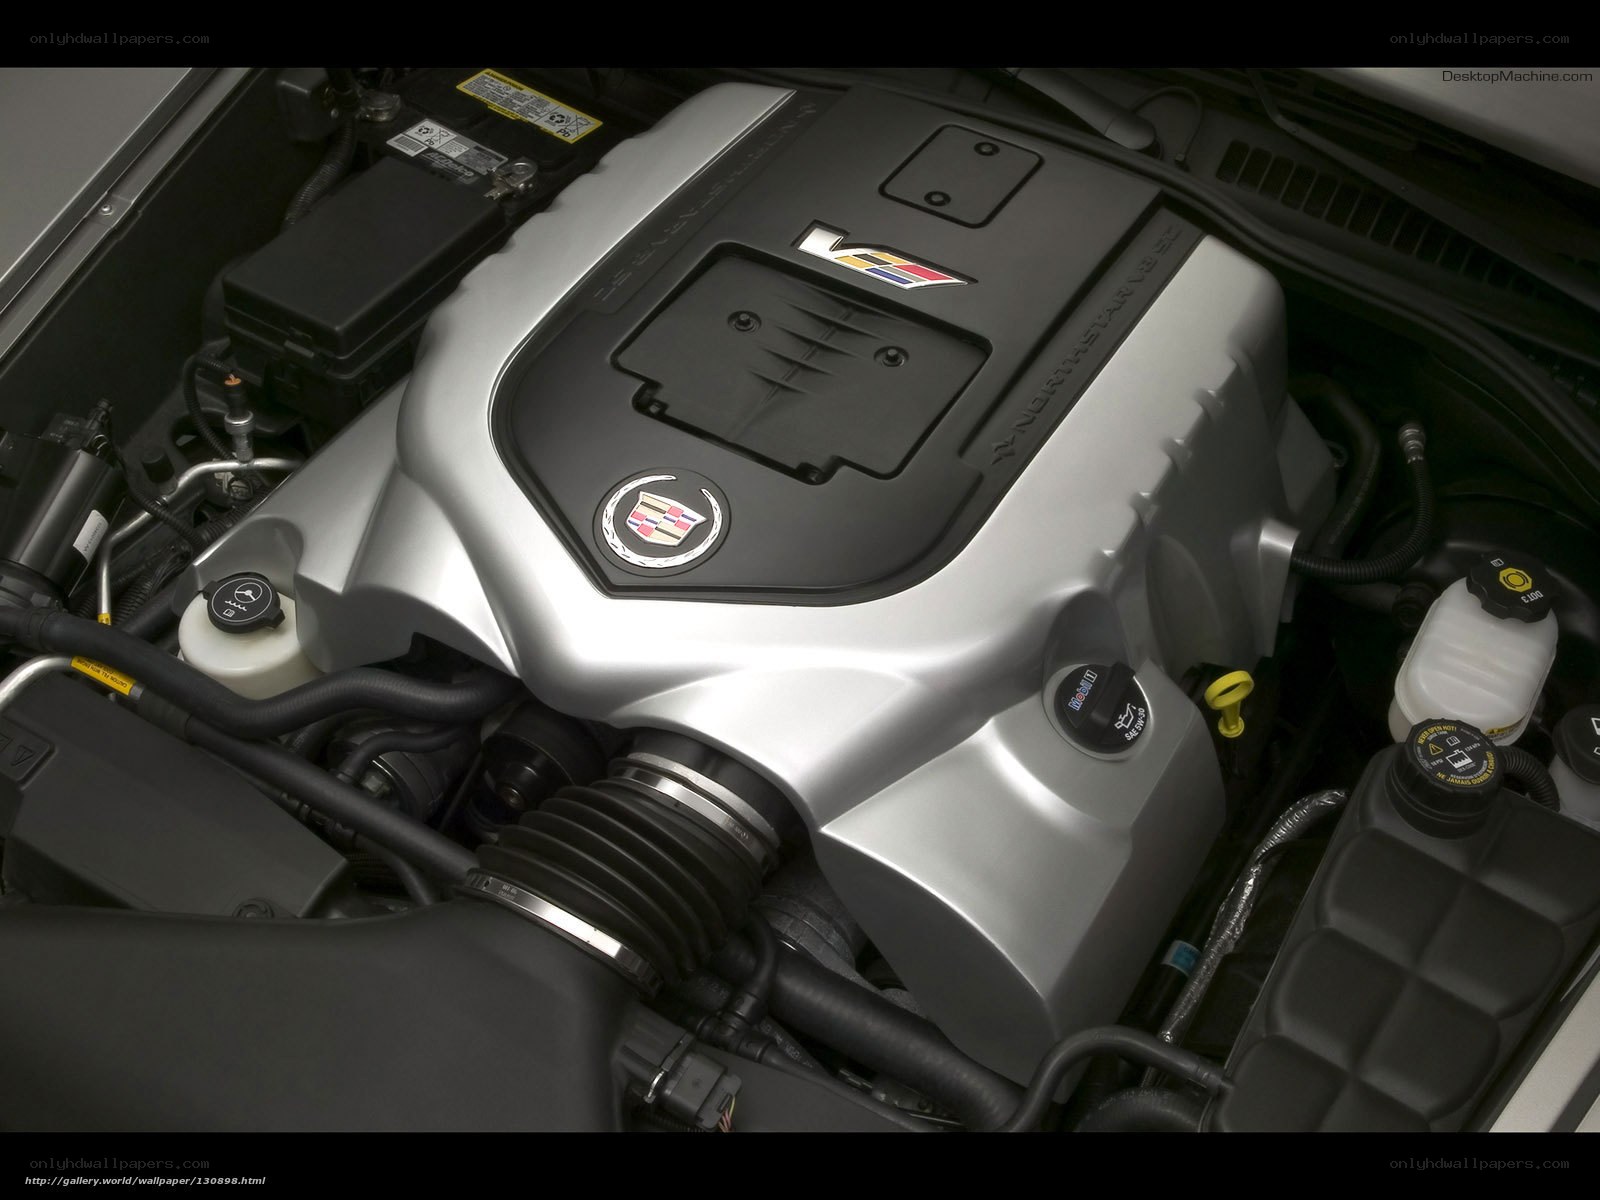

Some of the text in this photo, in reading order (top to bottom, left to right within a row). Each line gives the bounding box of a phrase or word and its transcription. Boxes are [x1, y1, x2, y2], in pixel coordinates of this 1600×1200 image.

[426, 152, 476, 178] ACDelco
[1015, 287, 1134, 433] NORTHSTAR
[1521, 590, 1544, 604] DOT 3
[1068, 679, 1092, 711] Mobil
[1124, 707, 1146, 741] SAE 5W-30
[1436, 771, 1446, 780] NE
[1446, 775, 1472, 786] JAMAIS
